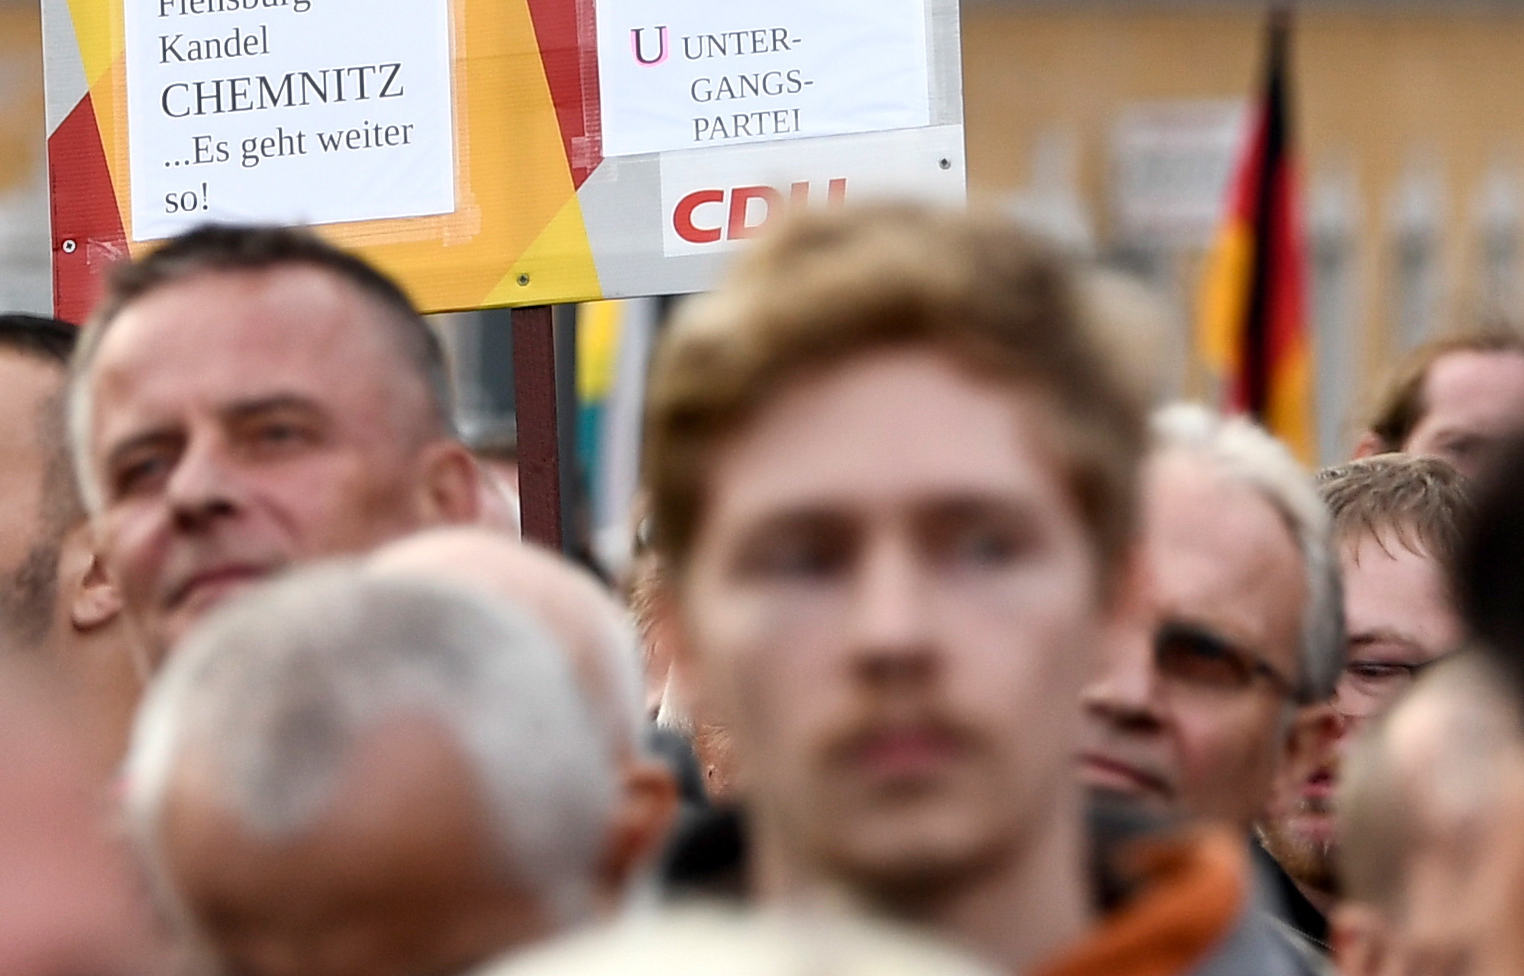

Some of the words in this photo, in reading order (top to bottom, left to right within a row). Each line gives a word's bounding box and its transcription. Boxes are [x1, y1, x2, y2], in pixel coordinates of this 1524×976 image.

[158, 25, 270, 64] Kandel
[630, 26, 667, 64] U
[682, 27, 802, 60] UNTER-
[161, 62, 404, 118] CHEMNITZ
[690, 69, 814, 102] GANGS-
[164, 134, 230, 168] ...Es
[241, 127, 306, 168] geht
[316, 120, 414, 152] weiter
[692, 108, 801, 142] PARTEI
[164, 182, 209, 214] so!
